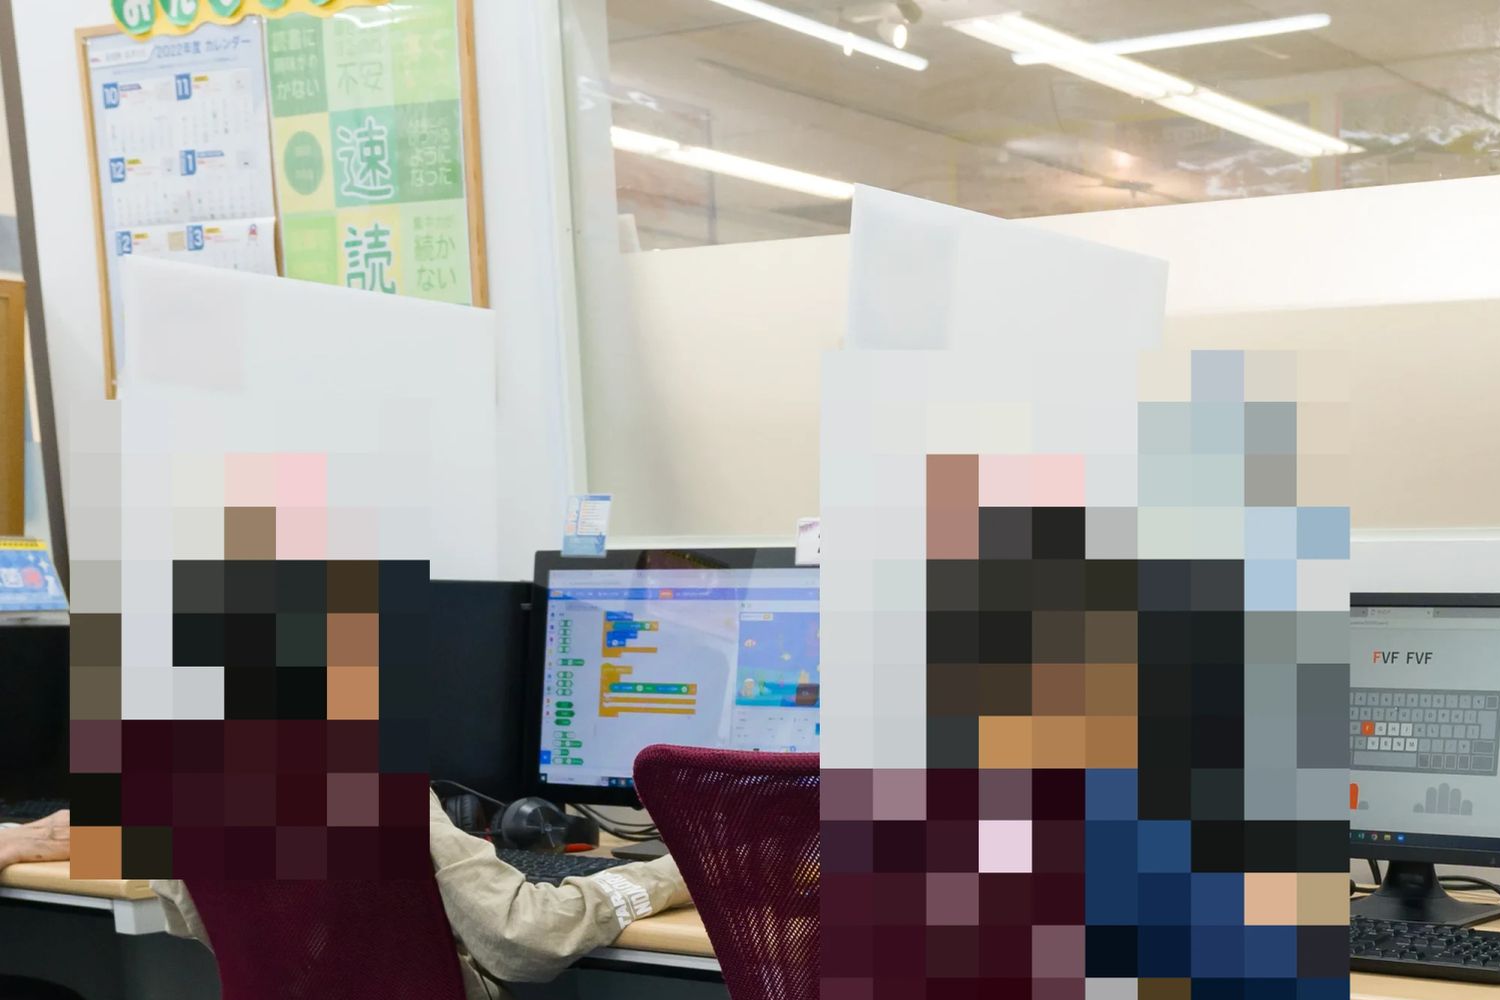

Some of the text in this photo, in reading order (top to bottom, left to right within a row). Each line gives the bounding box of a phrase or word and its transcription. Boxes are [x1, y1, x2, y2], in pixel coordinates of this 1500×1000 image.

[411, 168, 453, 188] なった
[416, 265, 457, 292] ない
[1373, 651, 1433, 665] FVF FVF
